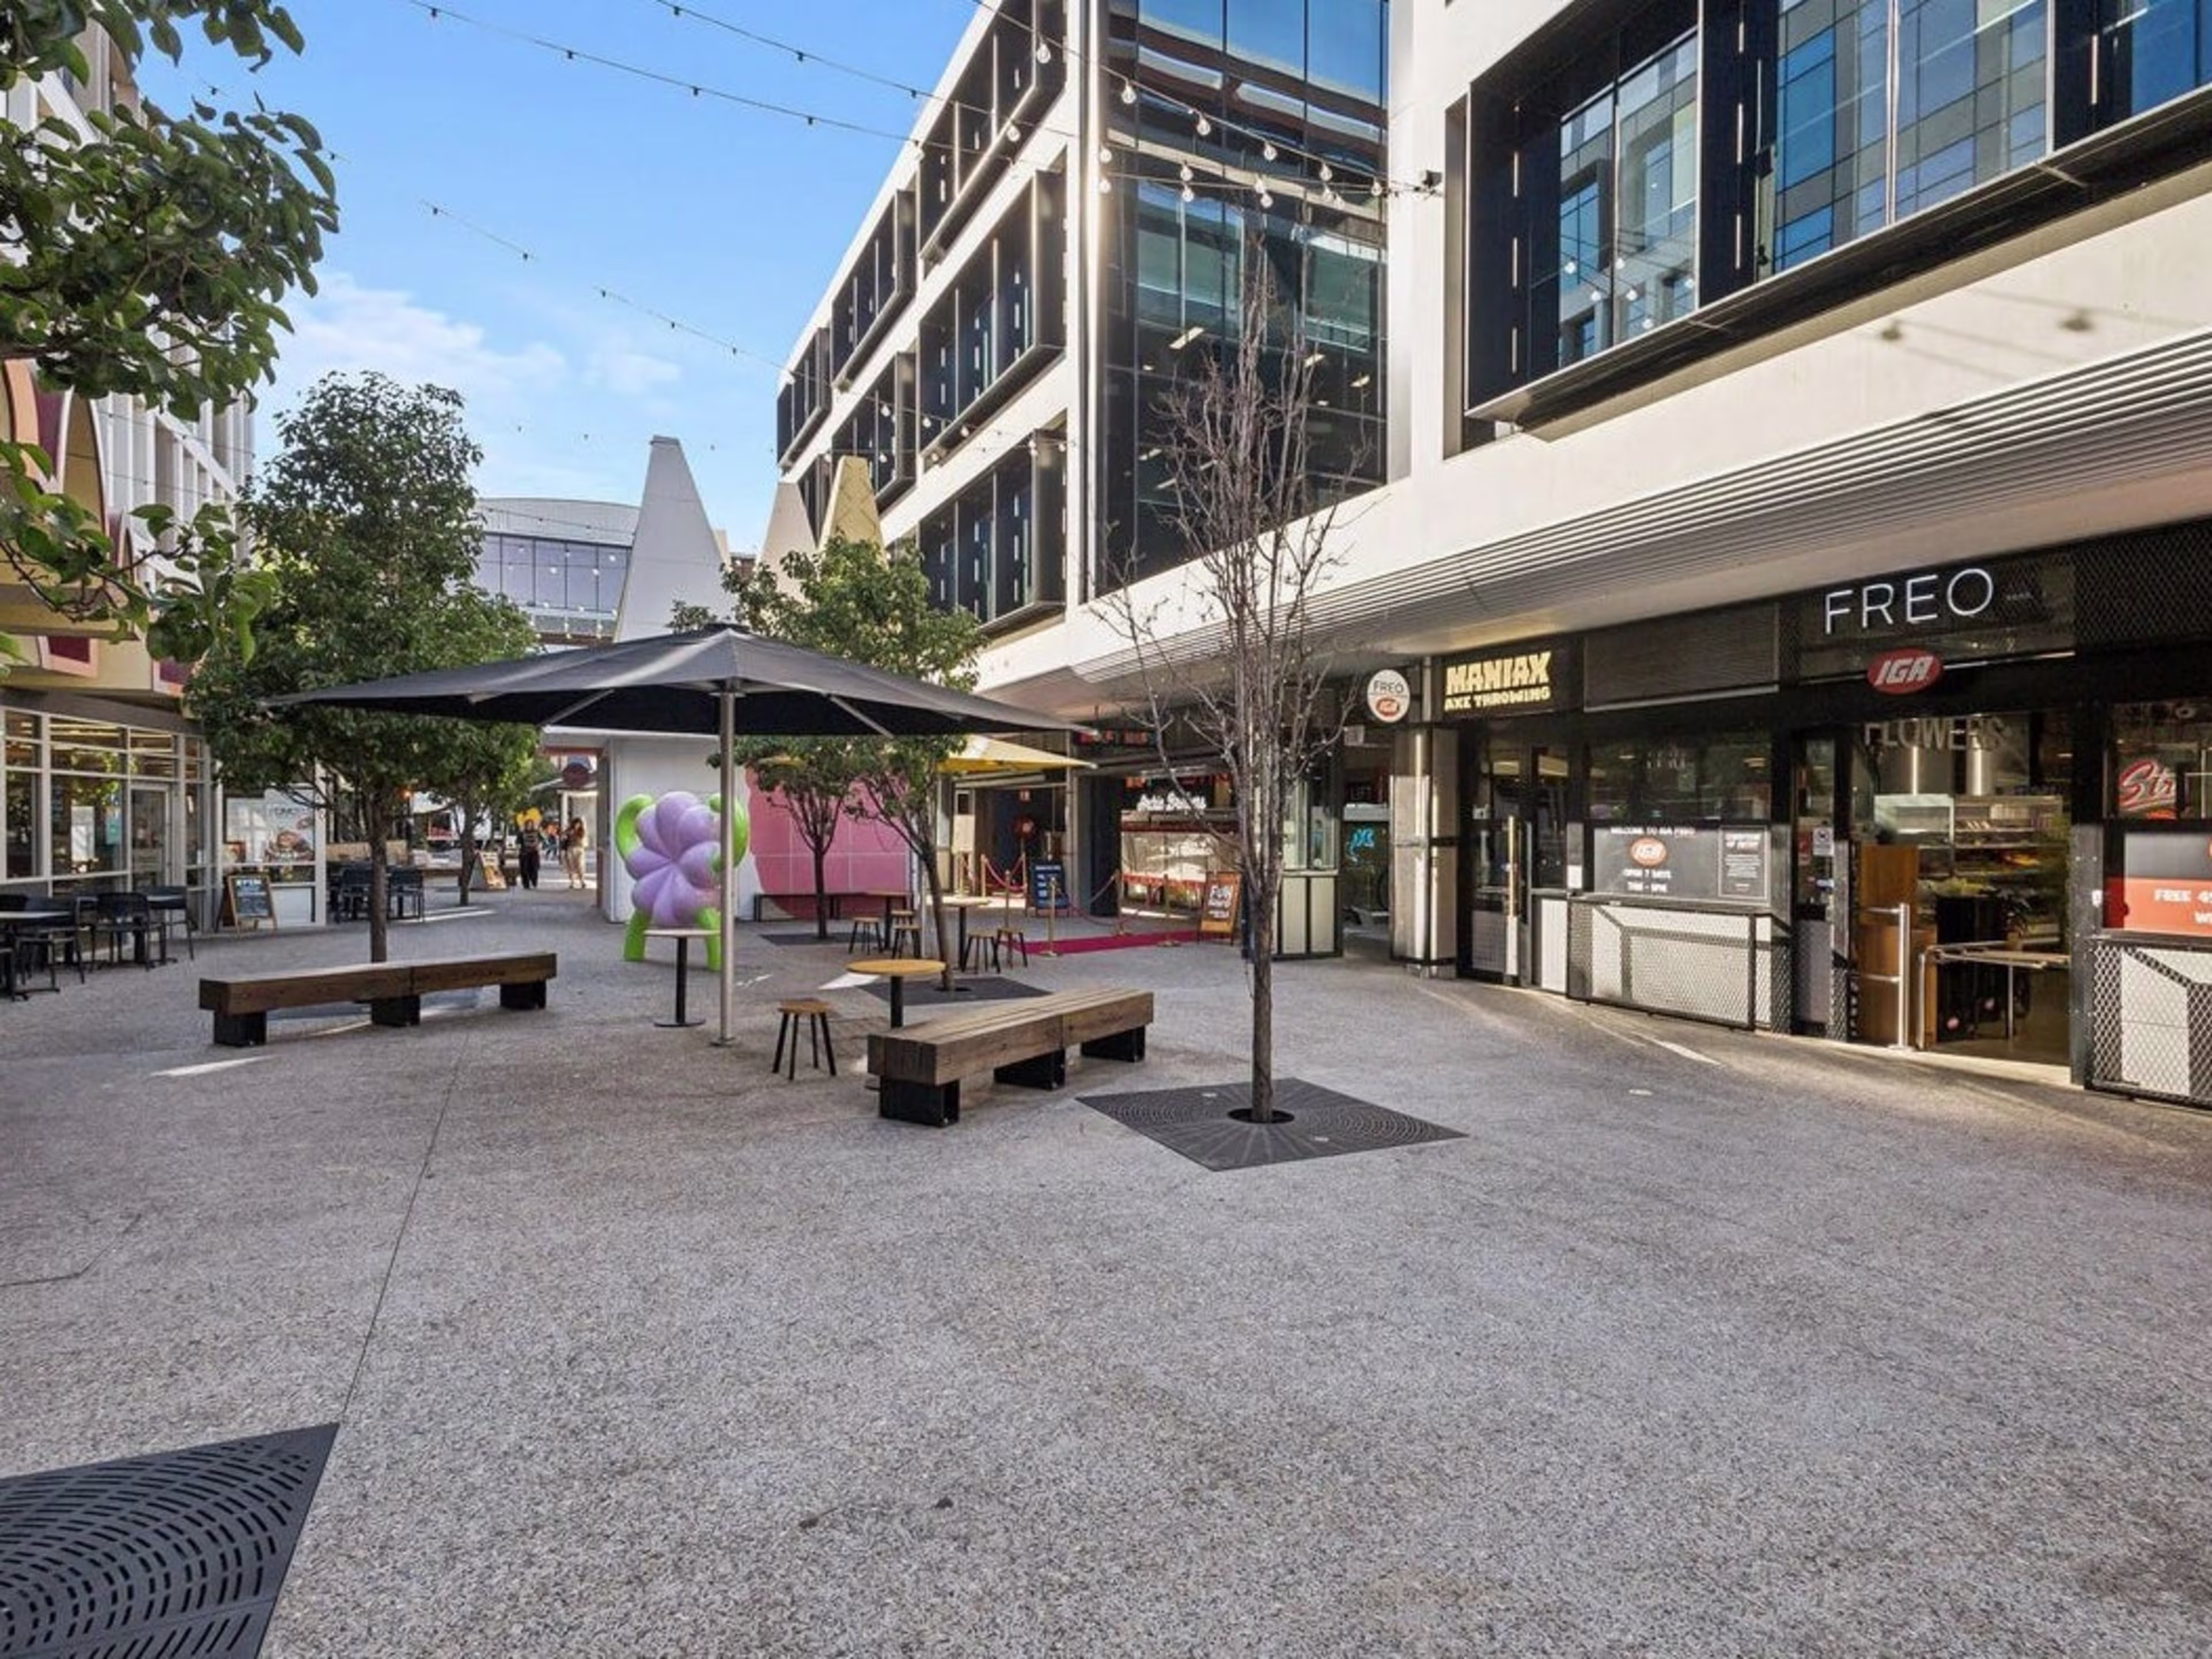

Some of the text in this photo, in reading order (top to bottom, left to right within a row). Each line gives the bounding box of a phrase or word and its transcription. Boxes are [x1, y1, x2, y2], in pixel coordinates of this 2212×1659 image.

[1825, 567, 1994, 634] FREO
[1445, 651, 1552, 696] MANIAX
[1873, 656, 1934, 685] IGA
[1444, 685, 1552, 712] AXE THROWING
[1864, 718, 2006, 752] FLOWERS
[2154, 889, 2191, 903] FREE
